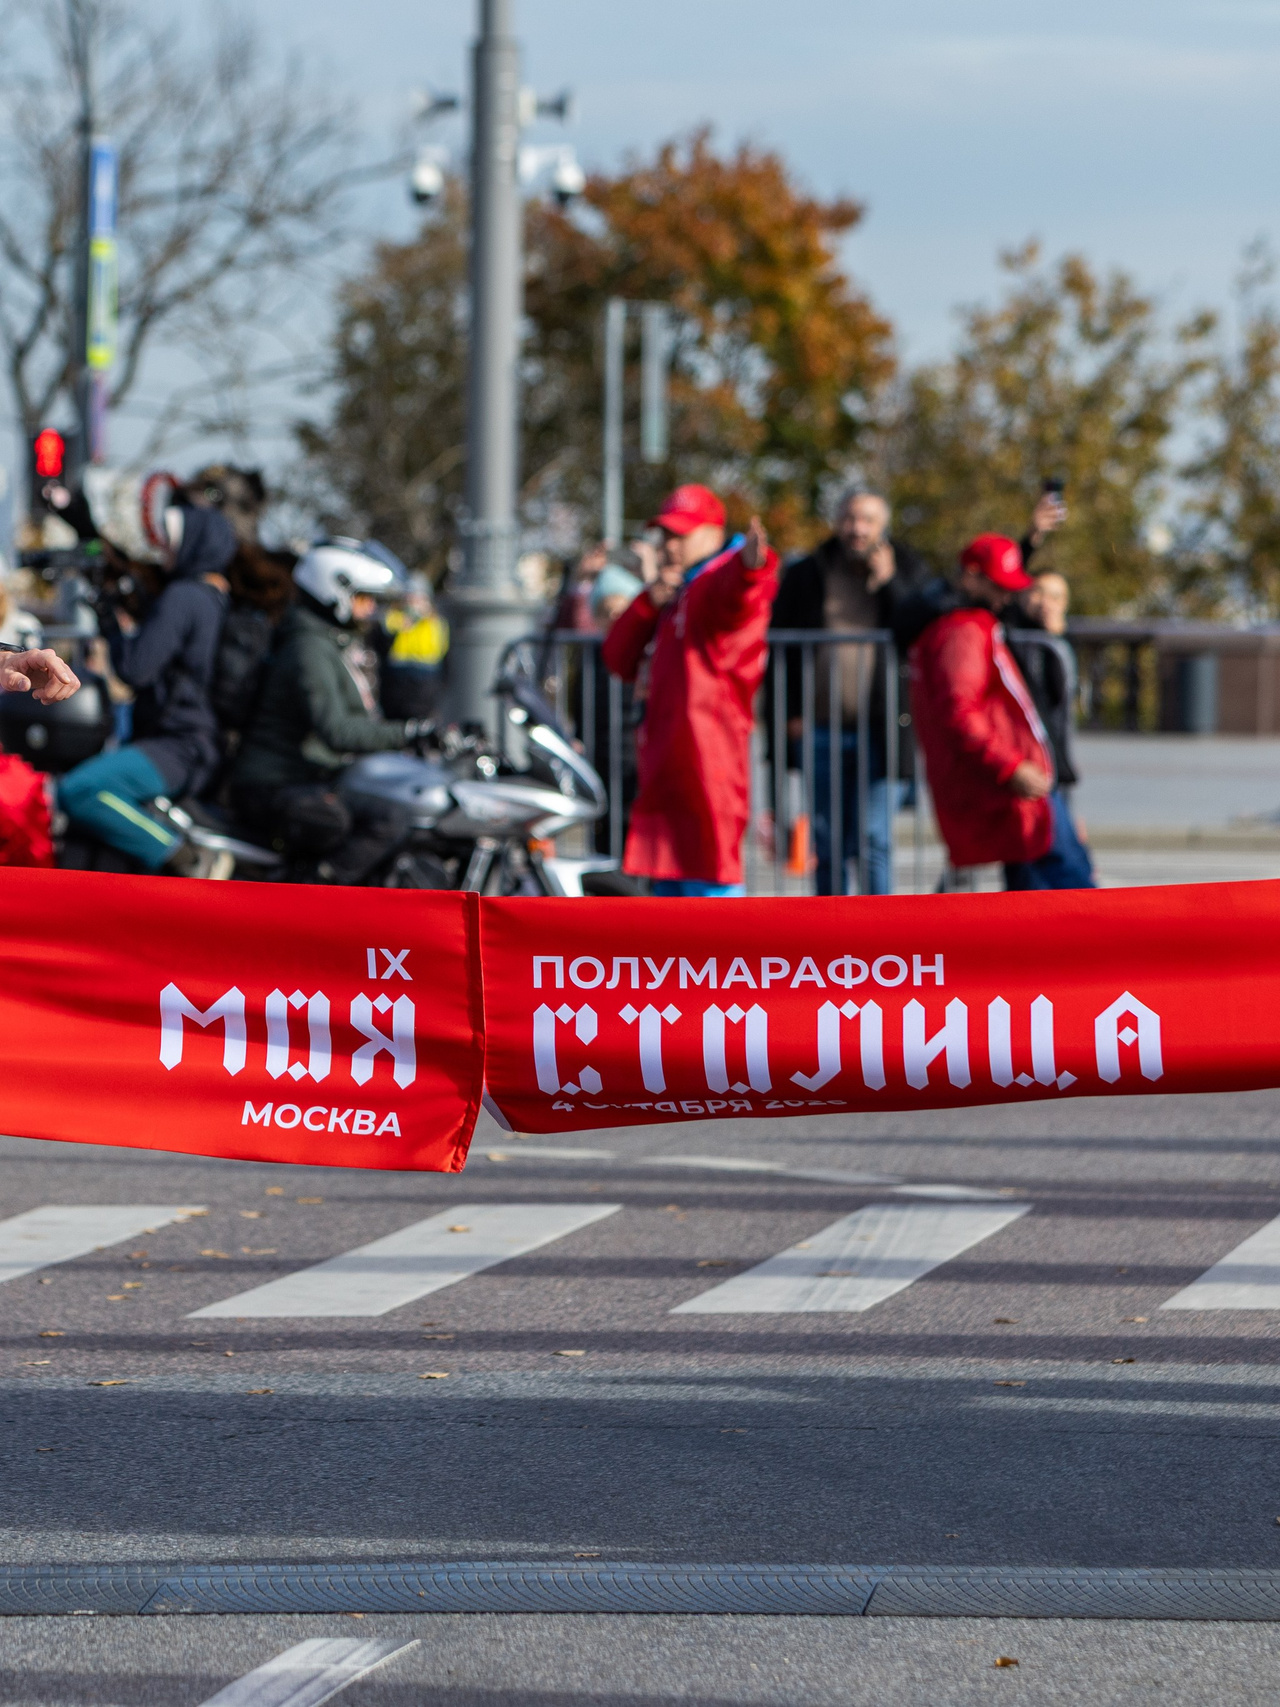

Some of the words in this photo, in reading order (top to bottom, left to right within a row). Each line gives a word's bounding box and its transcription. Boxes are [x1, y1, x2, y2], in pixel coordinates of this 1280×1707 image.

[366, 948, 414, 981] IX
[533, 954, 945, 990] ПОЛУМАРАФОН
[159, 981, 417, 1090] МОЯ
[533, 991, 1165, 1096] СТОЛИЦА
[241, 1100, 402, 1137] МОСКВА
